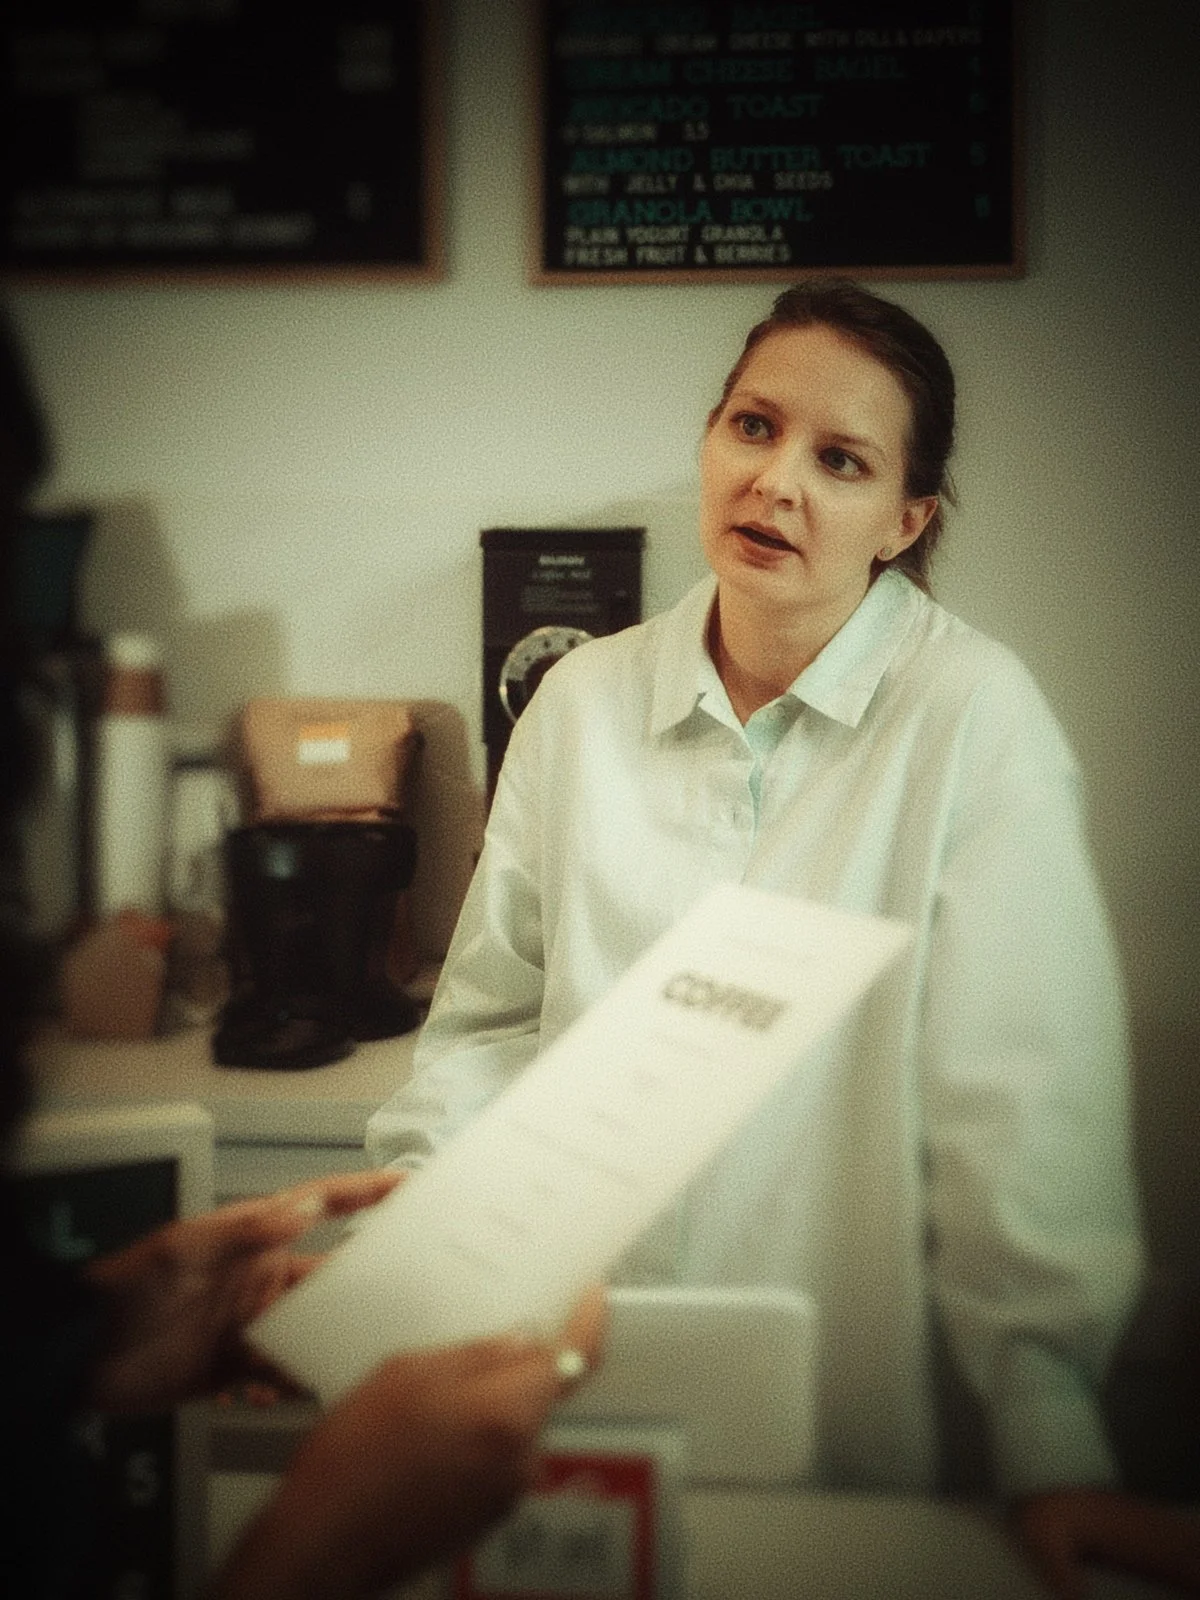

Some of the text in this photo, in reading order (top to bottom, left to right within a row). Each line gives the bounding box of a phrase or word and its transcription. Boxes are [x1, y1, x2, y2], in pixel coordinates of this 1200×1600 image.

[684, 57, 794, 84] CHEESE
[814, 55, 905, 81] BAGEL
[567, 94, 710, 121] AVOCADO
[725, 92, 824, 120] TOAST
[570, 147, 694, 174] ALMOND
[709, 146, 821, 173] BUTTER
[836, 142, 932, 170] TOAST
[624, 173, 678, 194] JELLY
[774, 170, 834, 191] SEEDS
[567, 199, 714, 225] GRANOLA
[730, 197, 814, 222] BOWL
[700, 223, 784, 242] GRANOLA
[563, 246, 629, 266] FRESH
[635, 244, 685, 264] FRUIT
[714, 243, 792, 263] BERRIES
